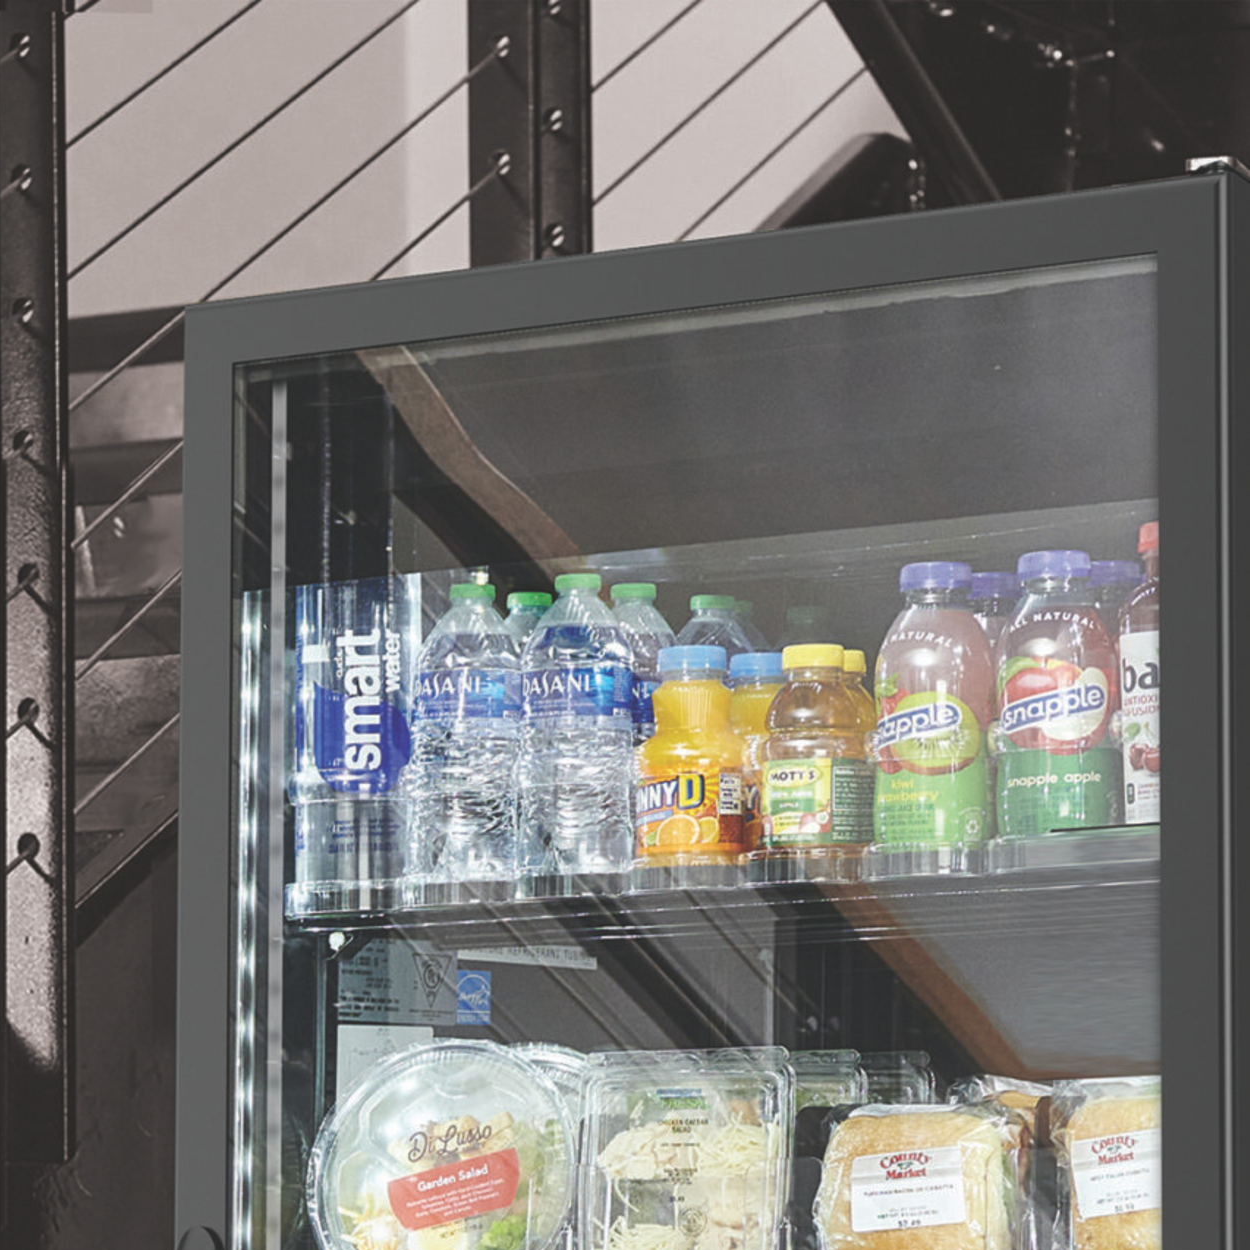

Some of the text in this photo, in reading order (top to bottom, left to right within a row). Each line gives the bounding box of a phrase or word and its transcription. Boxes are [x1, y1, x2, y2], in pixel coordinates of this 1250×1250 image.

[1033, 611, 1094, 629] NATURAL
[384, 628, 400, 693] water
[414, 666, 481, 698] DASANI
[523, 665, 590, 698] DASANI
[345, 628, 381, 770] smart
[1002, 686, 1104, 731] snapple
[417, 1163, 489, 1192] Garden Salad
[885, 1168, 927, 1181] Market
